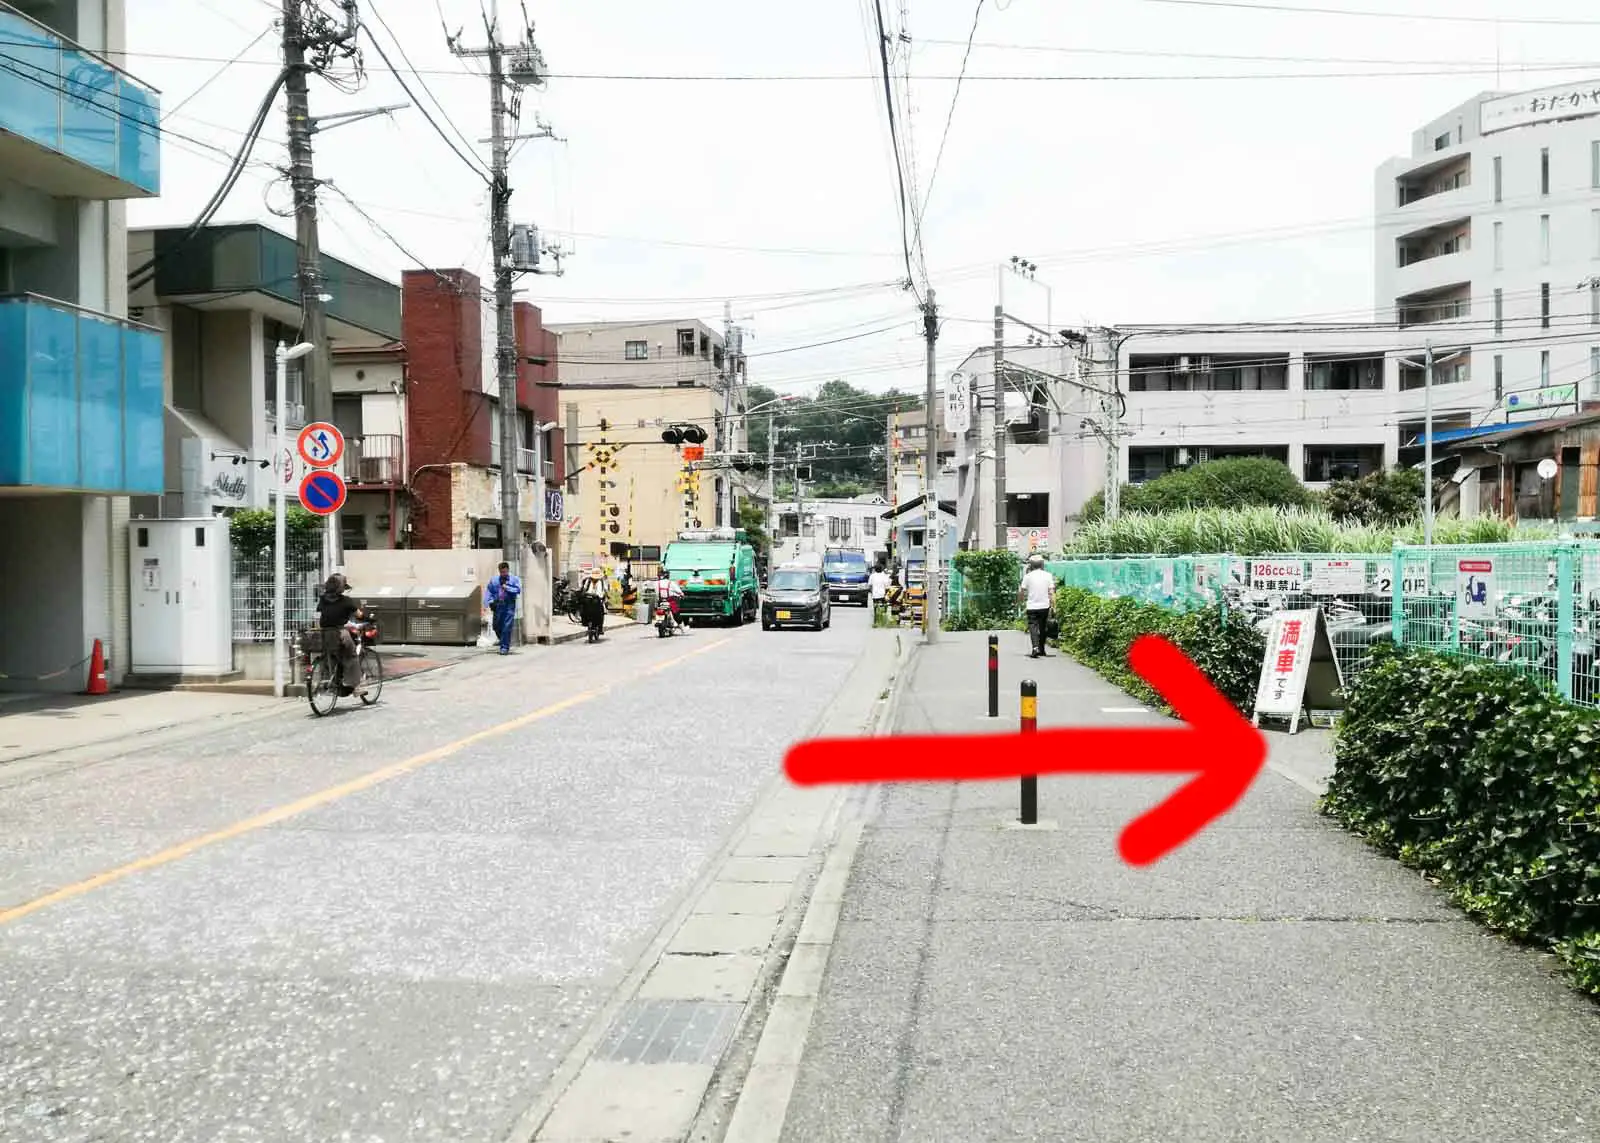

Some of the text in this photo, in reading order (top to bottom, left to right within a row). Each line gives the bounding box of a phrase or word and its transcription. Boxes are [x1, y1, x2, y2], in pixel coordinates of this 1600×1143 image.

[1253, 564, 1301, 576] 126cc以上
[1254, 580, 1301, 591] 駐車禁止
[1273, 619, 1302, 700] 満車です
